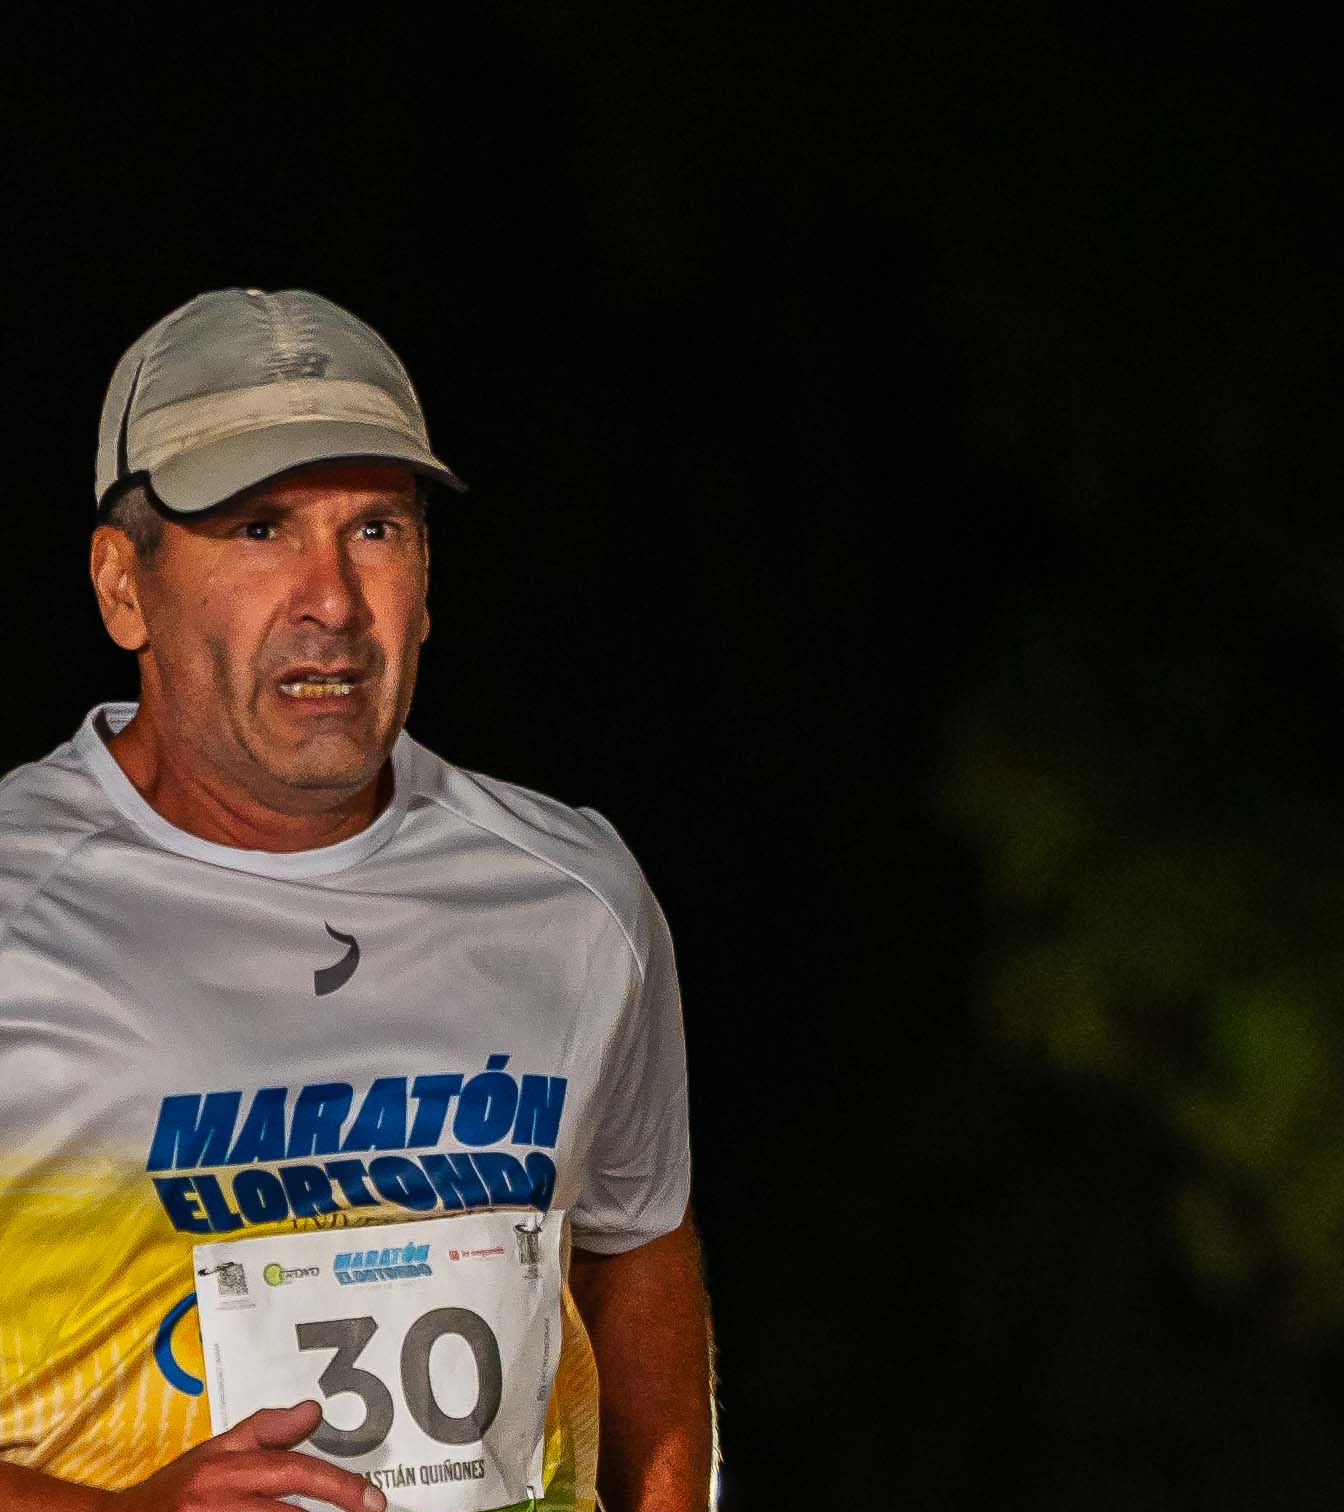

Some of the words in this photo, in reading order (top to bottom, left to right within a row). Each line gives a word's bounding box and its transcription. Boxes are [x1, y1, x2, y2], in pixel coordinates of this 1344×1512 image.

[146, 1054, 567, 1171] MARATÓN
[152, 1152, 556, 1232] ELORTONDO
[295, 1307, 503, 1458] 30
[420, 1459, 485, 1486] QUIÑONES
